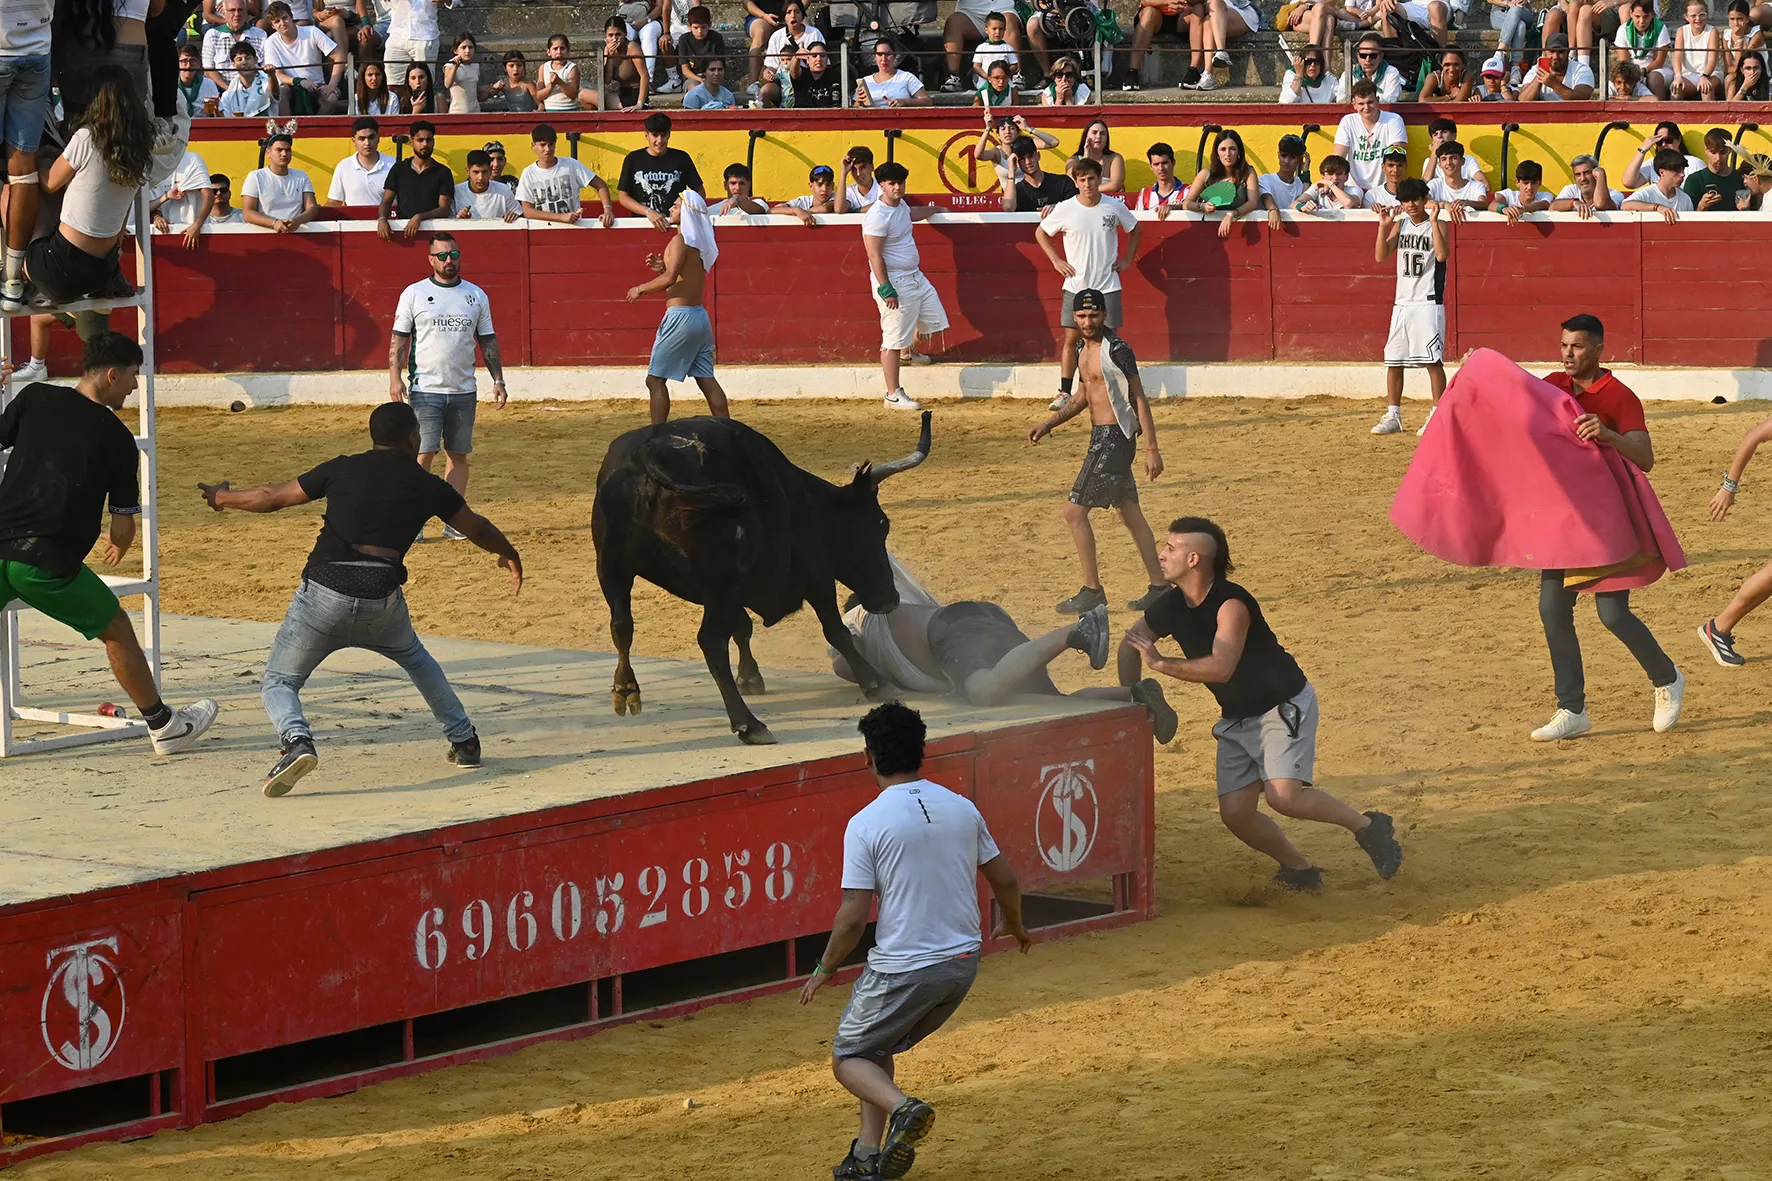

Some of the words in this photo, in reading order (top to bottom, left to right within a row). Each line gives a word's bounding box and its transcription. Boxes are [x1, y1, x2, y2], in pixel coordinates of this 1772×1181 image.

[959, 144, 977, 188] 1
[1402, 251, 1426, 278] 16
[414, 841, 795, 970] 696052858
